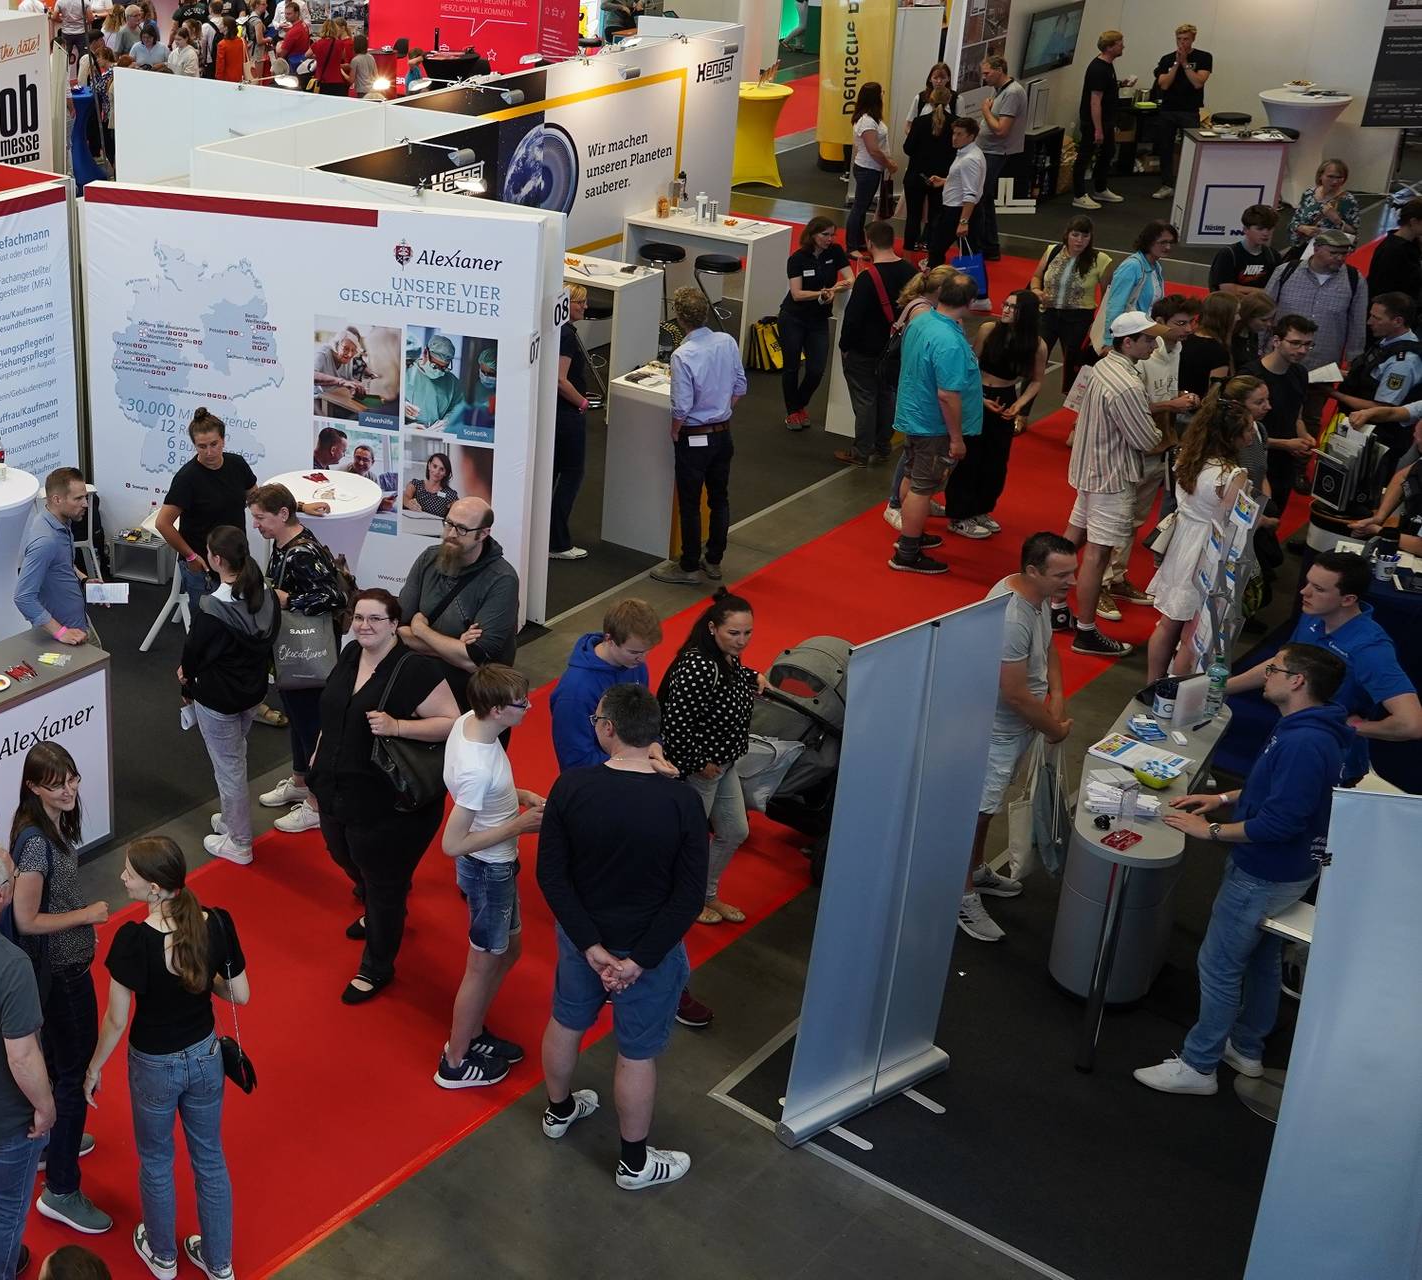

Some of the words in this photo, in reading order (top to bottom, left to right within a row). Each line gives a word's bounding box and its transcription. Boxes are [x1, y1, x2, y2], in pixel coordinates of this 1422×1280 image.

[440, 4, 470, 12] HERZLICH
[470, 5, 514, 17] WILLKOMMEN!
[17, 34, 41, 56] date!
[696, 55, 734, 83] Hengst
[0, 133, 40, 157] messe
[588, 143, 607, 158] Wir
[608, 133, 648, 154] machen
[586, 160, 628, 179] unseren
[629, 145, 673, 168] Planeten
[584, 177, 631, 199] sauberer.
[417, 250, 503, 271] Alexianer
[31, 276, 52, 291] (MFA)
[391, 277, 457, 297] UNSERE
[461, 283, 501, 301] VIER
[339, 287, 500, 317] GESCHÄFTSFELDER
[554, 297, 570, 326] 08
[530, 336, 541, 365] 07
[127, 398, 176, 418] 30.000
[178, 408, 258, 430] Miitende
[364, 416, 395, 426] Altenhilfe
[160, 418, 176, 434] 12
[462, 428, 488, 438] Somatik
[167, 436, 176, 449] 6
[167, 451, 176, 465] 8
